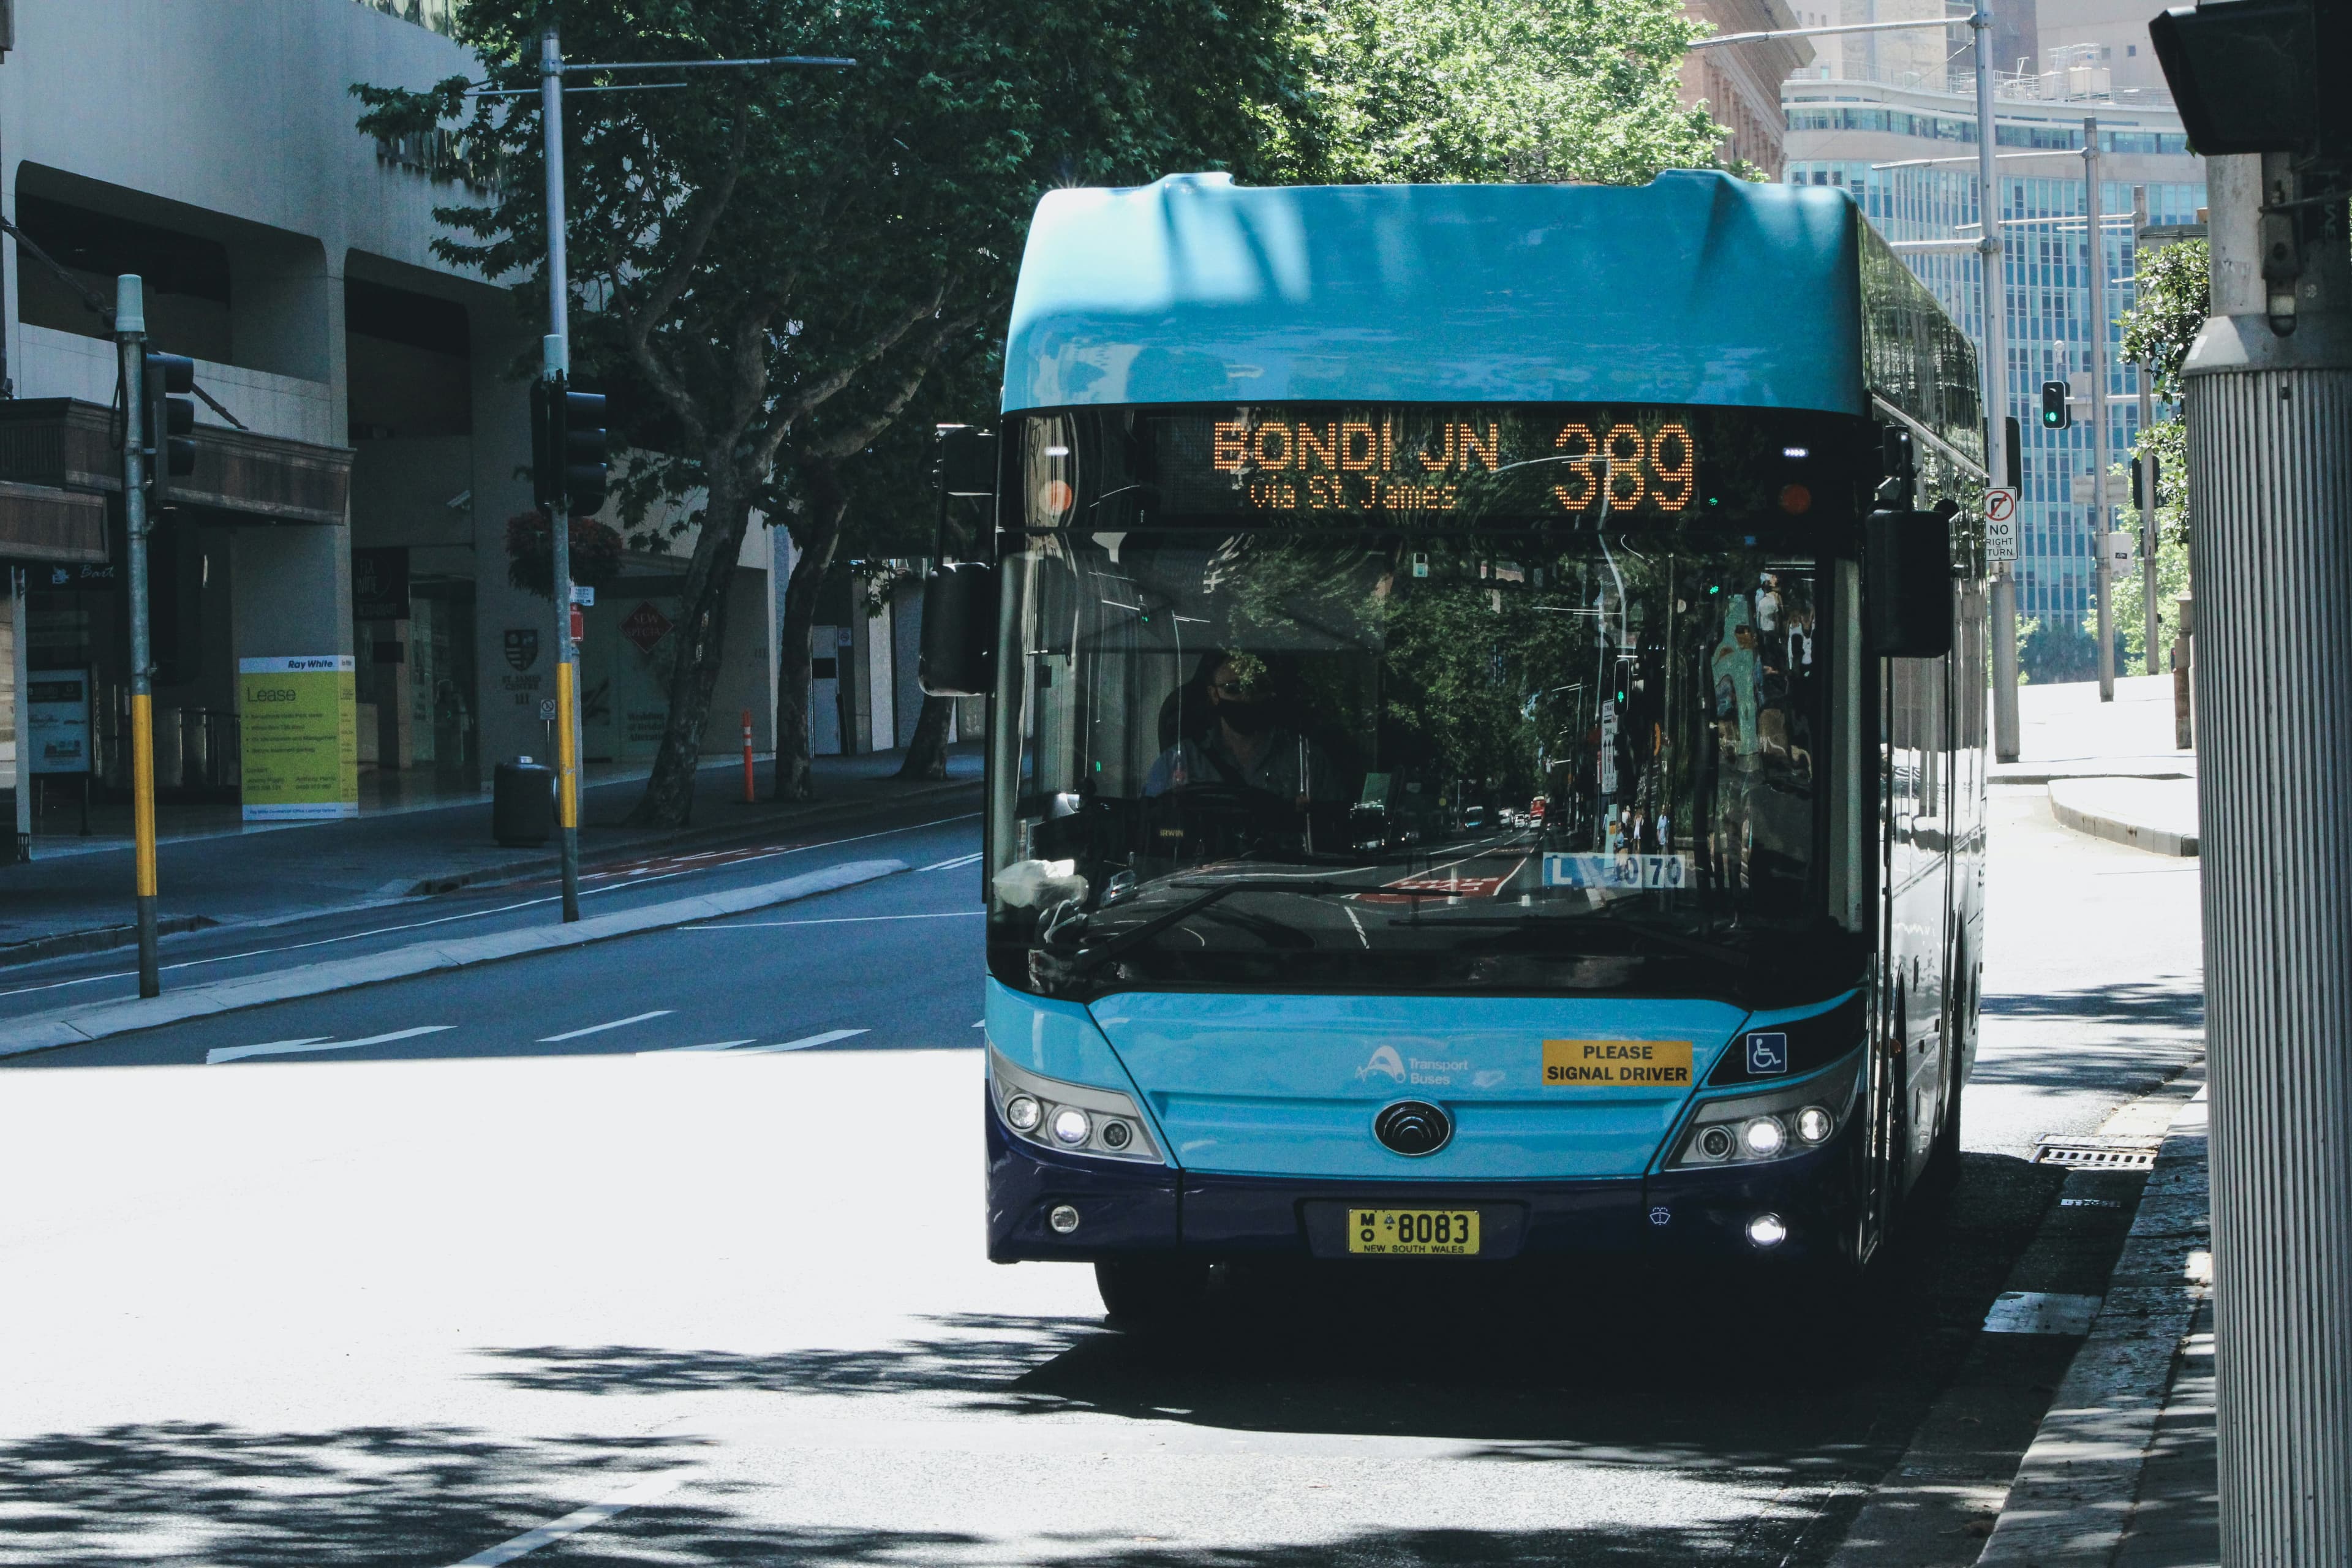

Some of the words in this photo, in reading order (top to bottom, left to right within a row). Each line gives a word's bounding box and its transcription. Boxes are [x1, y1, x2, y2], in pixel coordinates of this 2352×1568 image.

[1214, 422, 1392, 470] BONDI
[1419, 423, 1498, 471] JN
[1555, 423, 1694, 511] 389
[1250, 475, 1295, 509] via
[1309, 475, 1346, 509] St
[1360, 475, 1457, 509] James
[1989, 524, 2008, 535] NO
[1986, 537, 2013, 546] RIGHT
[288, 660, 306, 669] Ray
[307, 660, 333, 668] White
[247, 687, 296, 703] Lease
[1583, 1045, 1653, 1060] PLEASE
[1408, 1058, 1469, 1072] Transport
[1411, 1073, 1450, 1085] Buses
[1547, 1066, 1614, 1080] SIGNAL
[1620, 1067, 1687, 1081] DRIVER
[1398, 1213, 1469, 1244] 8083
[1392, 1245, 1425, 1253] SOUTH
